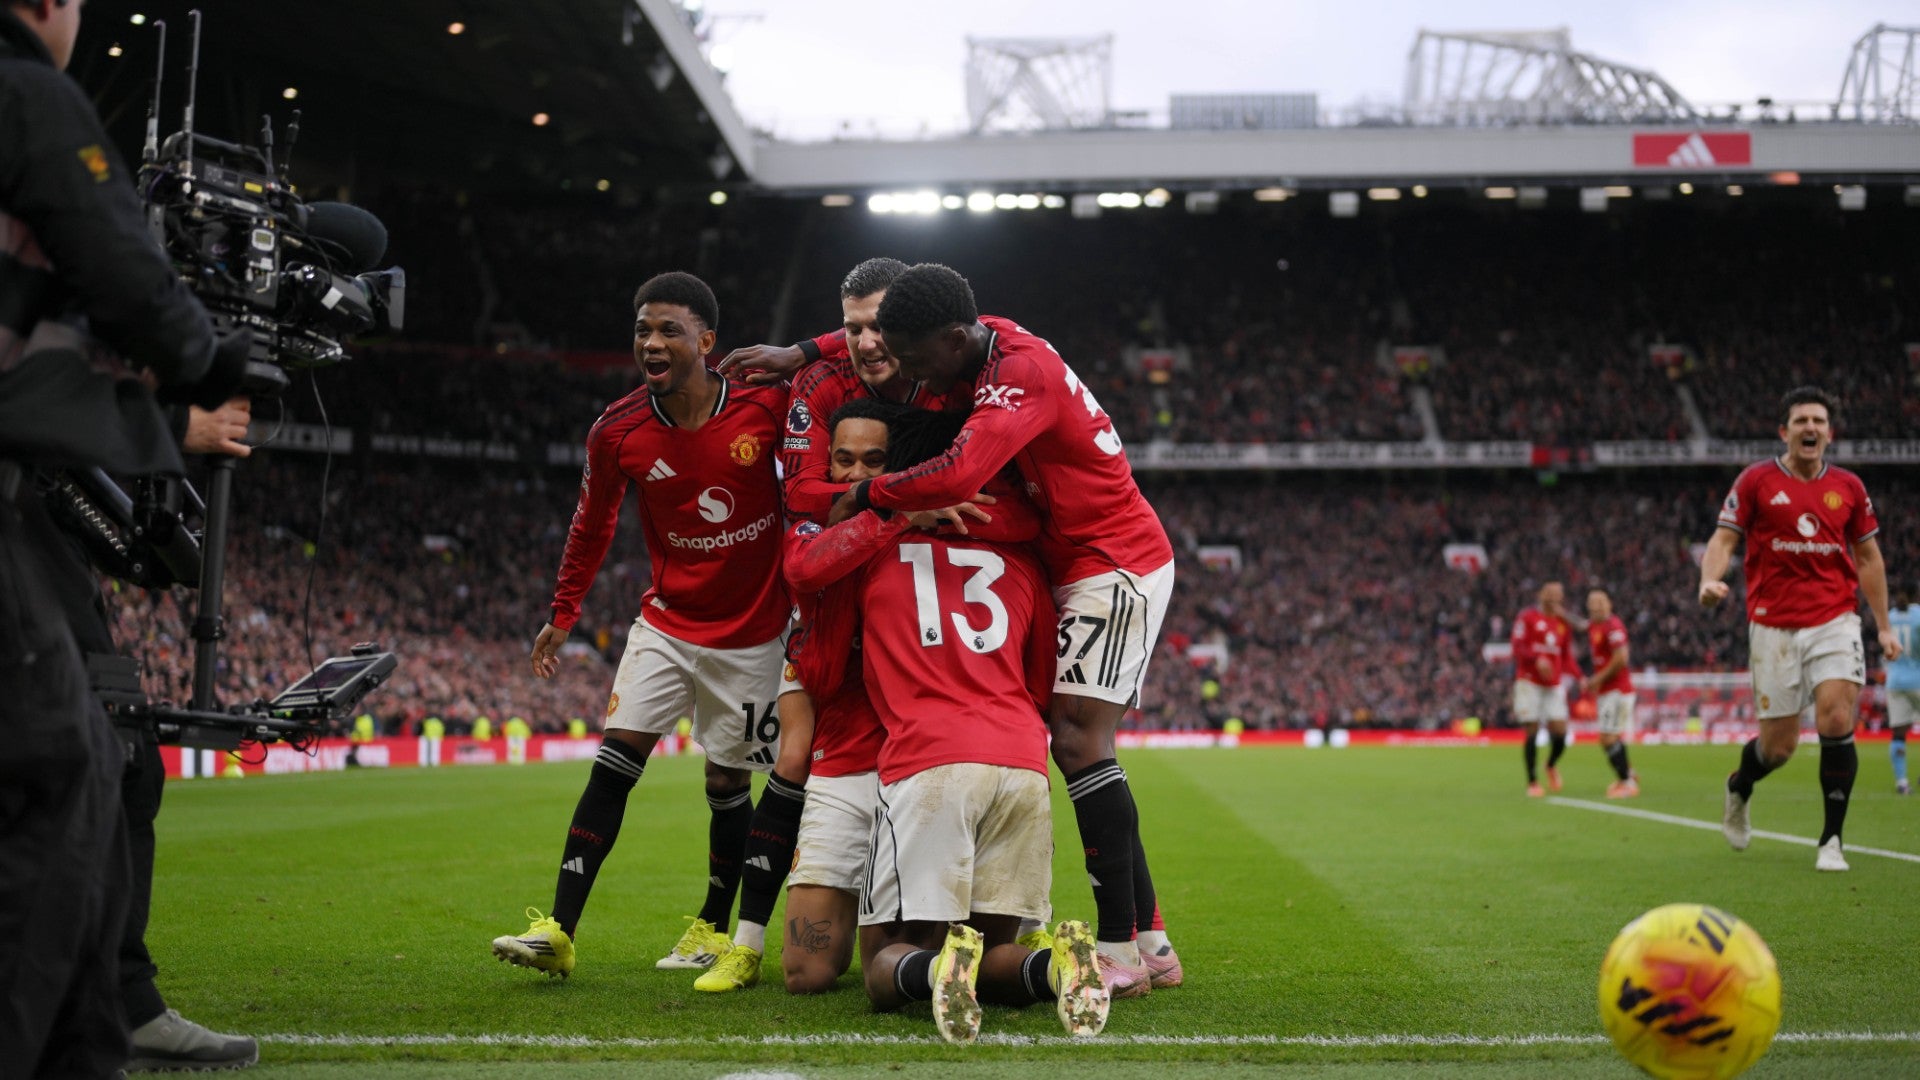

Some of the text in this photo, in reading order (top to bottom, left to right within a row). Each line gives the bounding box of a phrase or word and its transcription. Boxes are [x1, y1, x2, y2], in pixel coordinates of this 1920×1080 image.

[668, 513, 776, 553] Snapdragon
[1772, 538, 1843, 556] Snapdragon
[899, 544, 1009, 654] 13
[1057, 616, 1107, 659] 37
[742, 702, 781, 744] 16
